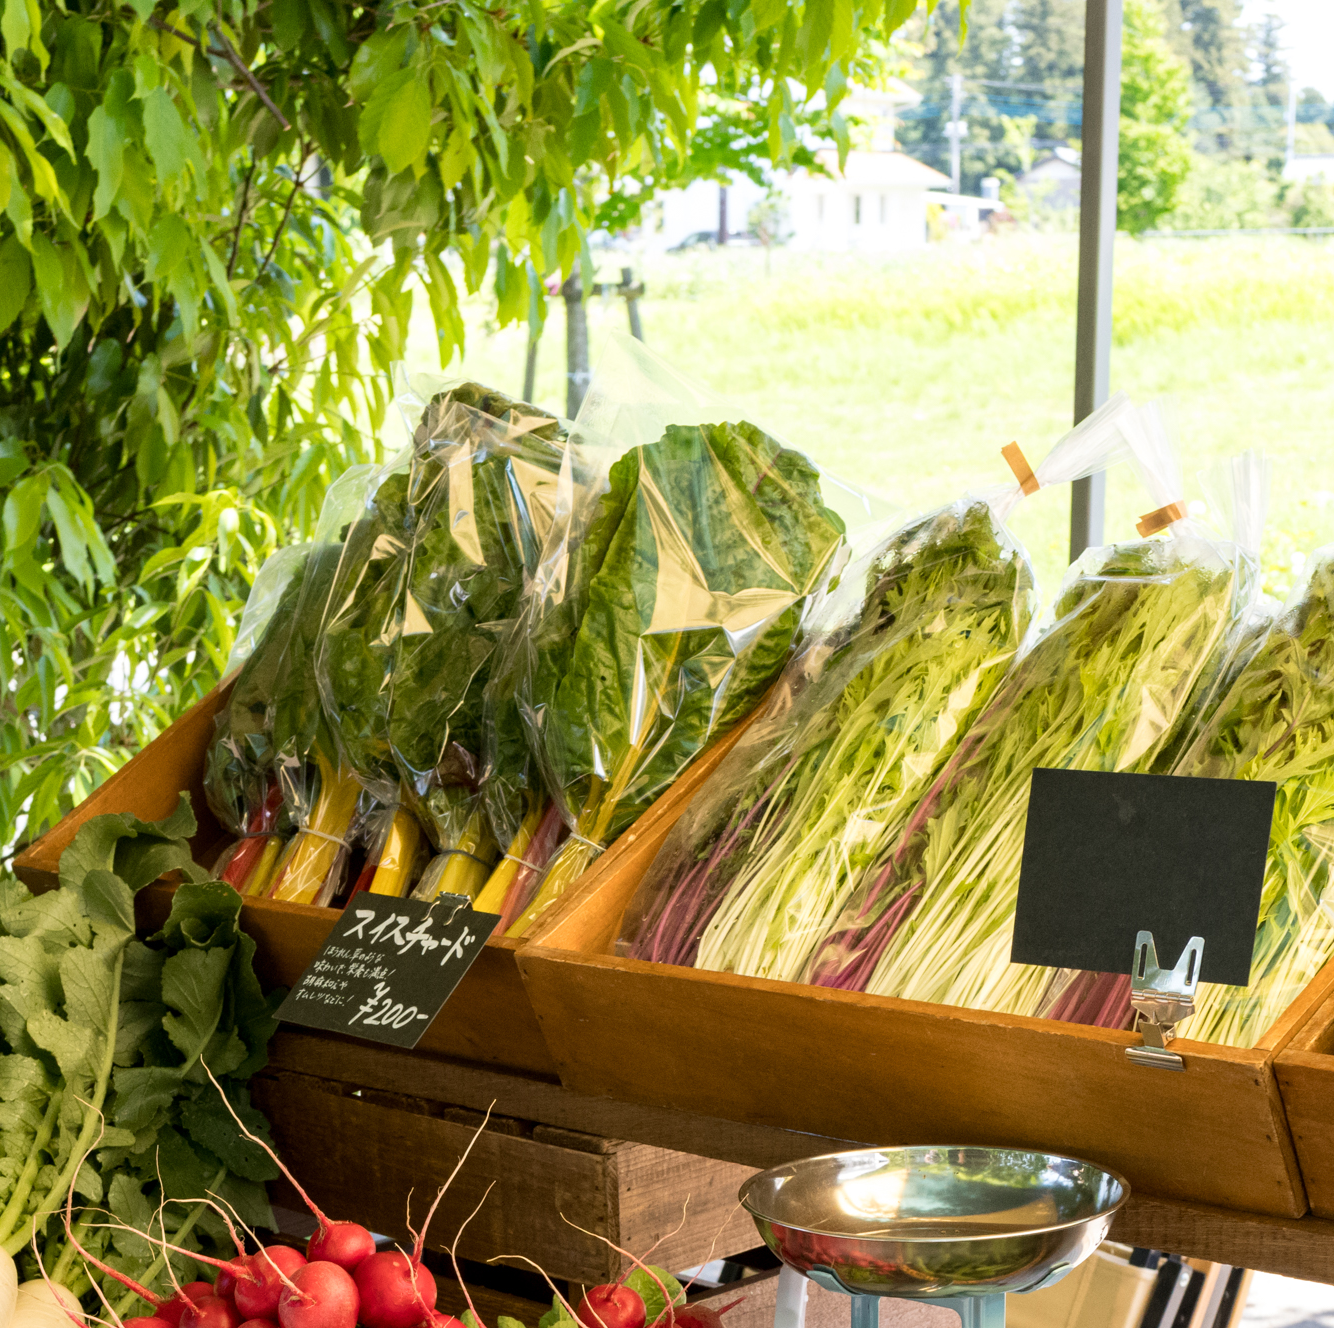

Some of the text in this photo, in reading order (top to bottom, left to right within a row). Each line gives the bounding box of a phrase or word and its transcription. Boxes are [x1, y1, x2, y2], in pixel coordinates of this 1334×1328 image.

[342, 909, 477, 966] スイスチャード
